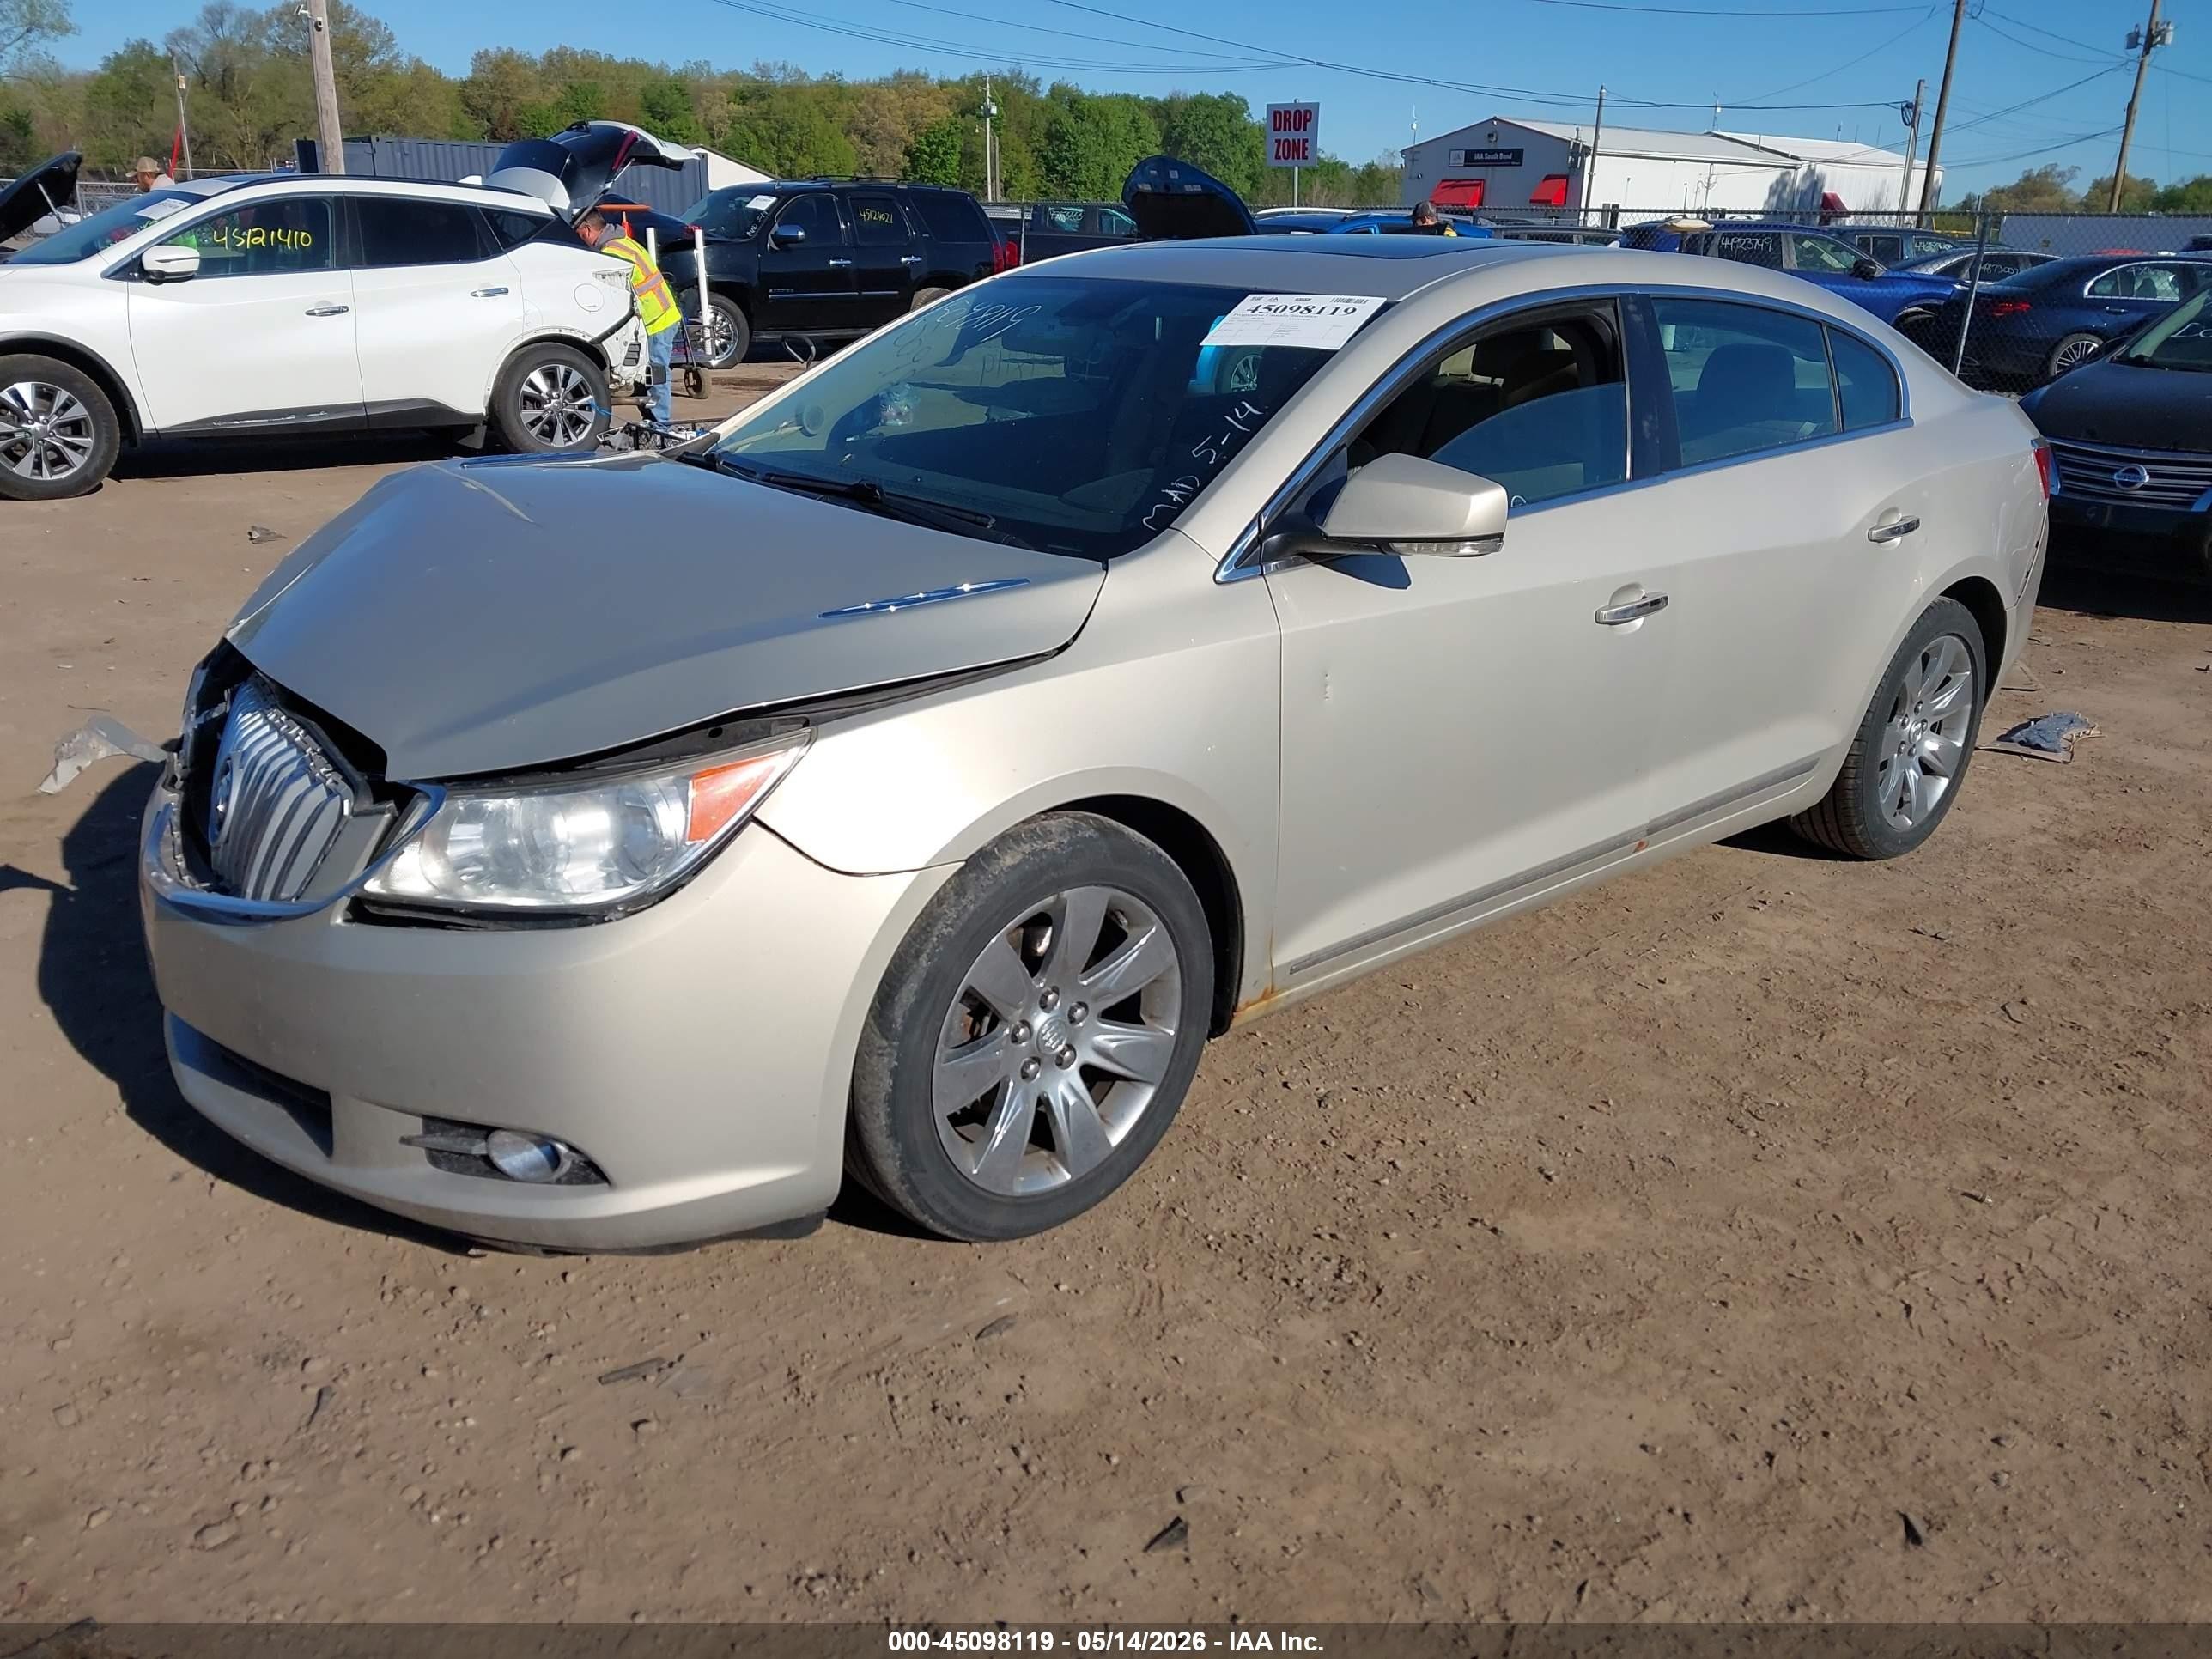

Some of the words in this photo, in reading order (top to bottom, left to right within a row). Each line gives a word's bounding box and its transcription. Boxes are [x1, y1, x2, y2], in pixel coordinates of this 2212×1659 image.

[1273, 109, 1313, 132] DROP
[1274, 137, 1310, 161] ZONE
[213, 226, 313, 250] 45121410
[1721, 236, 1773, 252] 44923749
[1246, 304, 1358, 316] 45098119
[1191, 401, 1265, 465] 5-14
